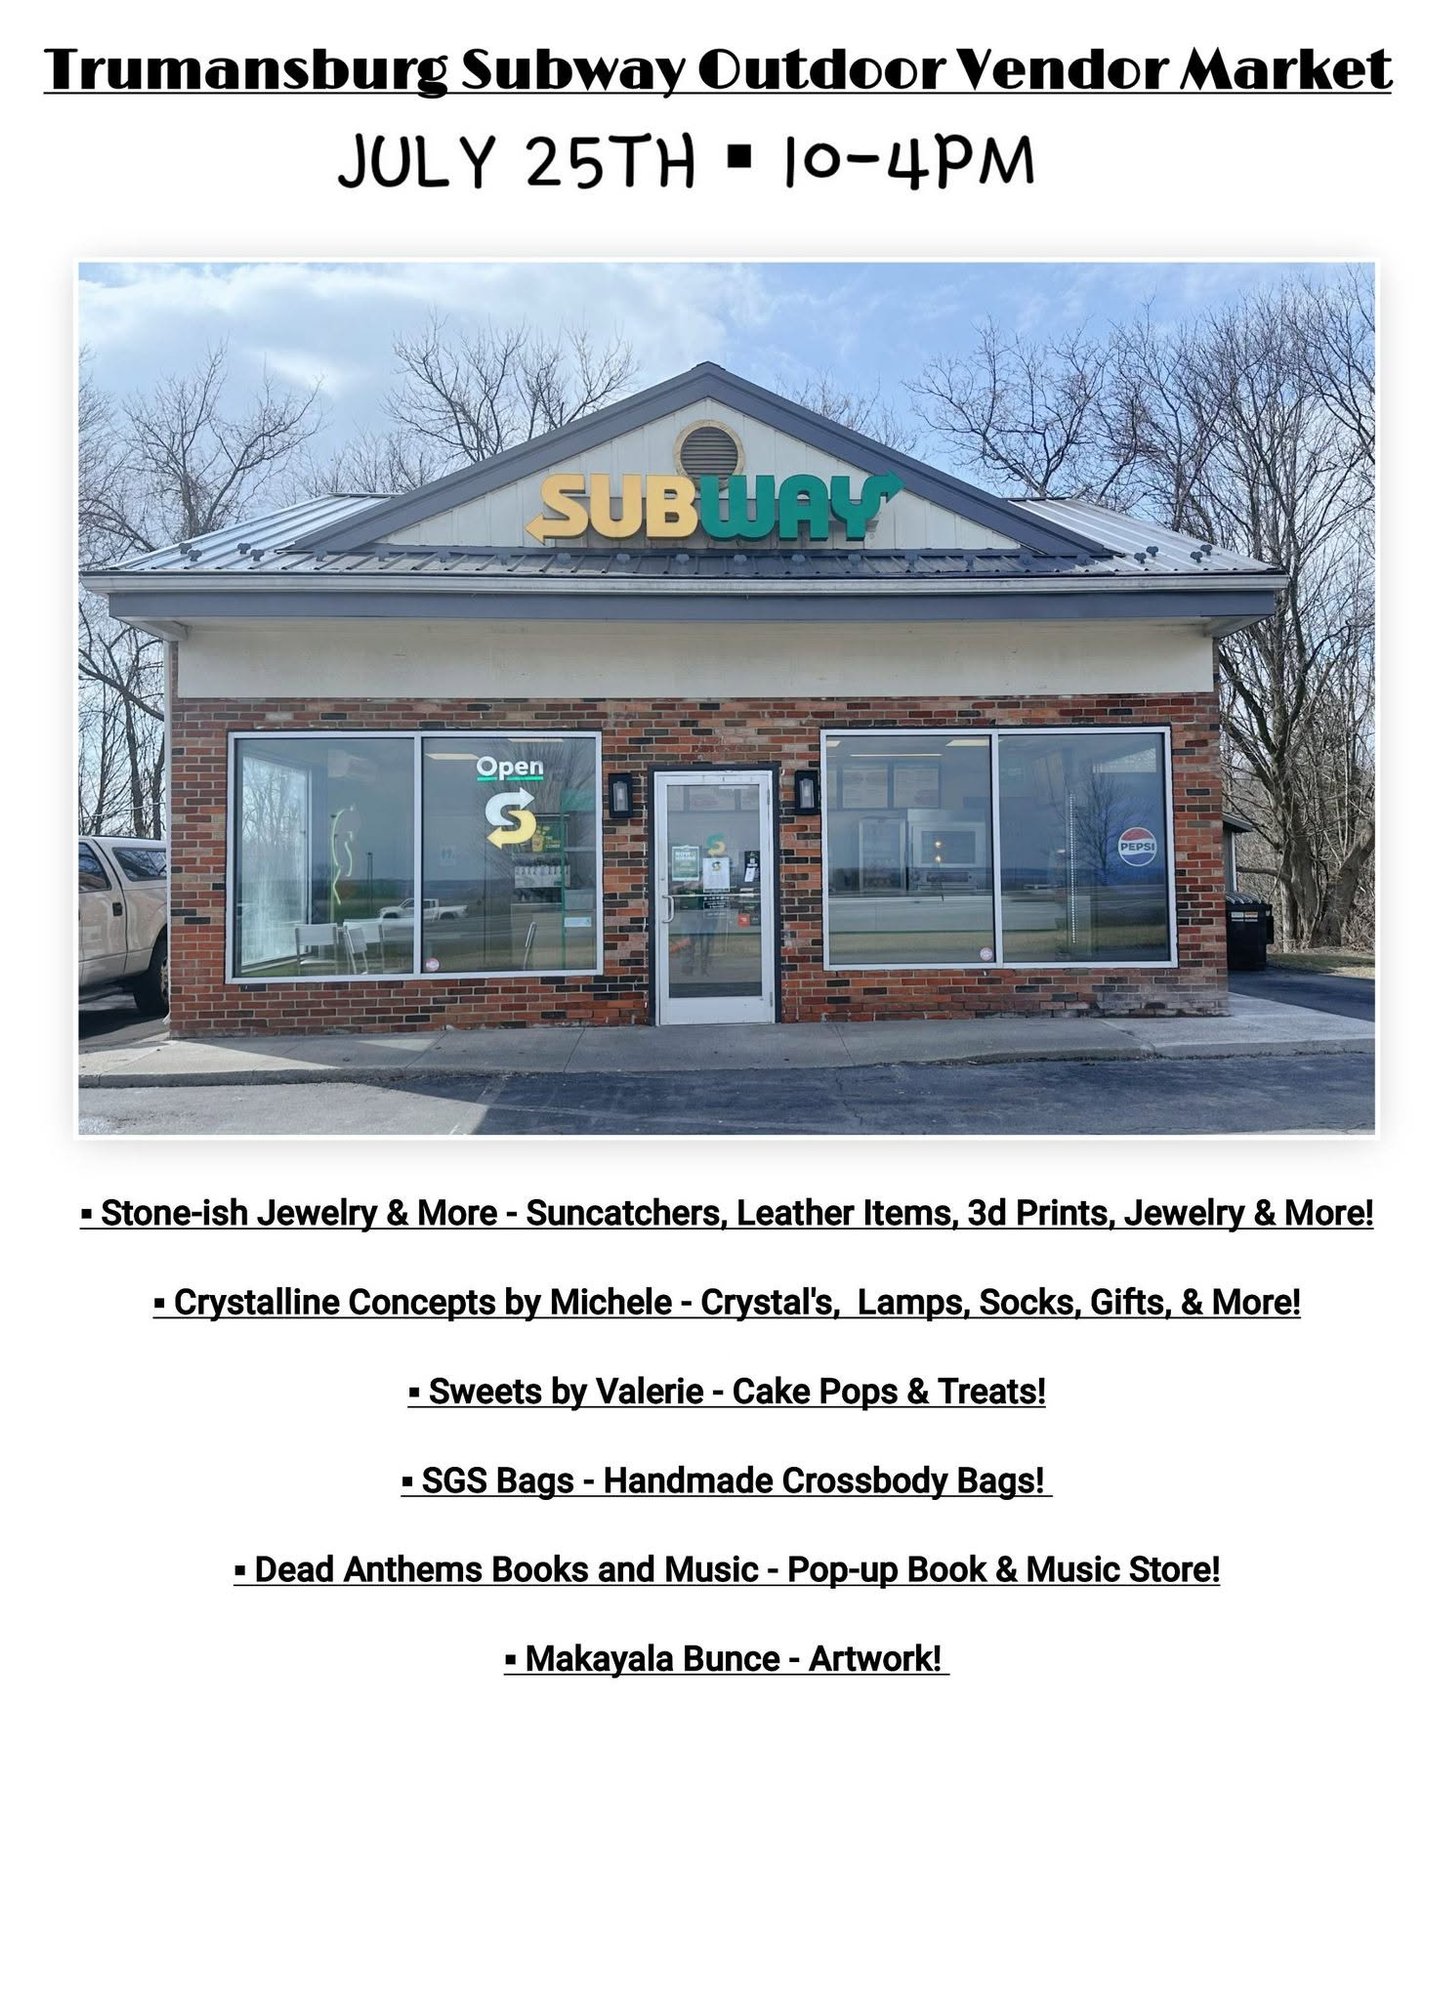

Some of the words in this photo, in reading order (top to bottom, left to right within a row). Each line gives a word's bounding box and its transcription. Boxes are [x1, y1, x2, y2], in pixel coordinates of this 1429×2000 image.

[525, 471, 904, 545] SUBWAY
[476, 756, 544, 781] Open
[1120, 842, 1155, 852] PEPSI
